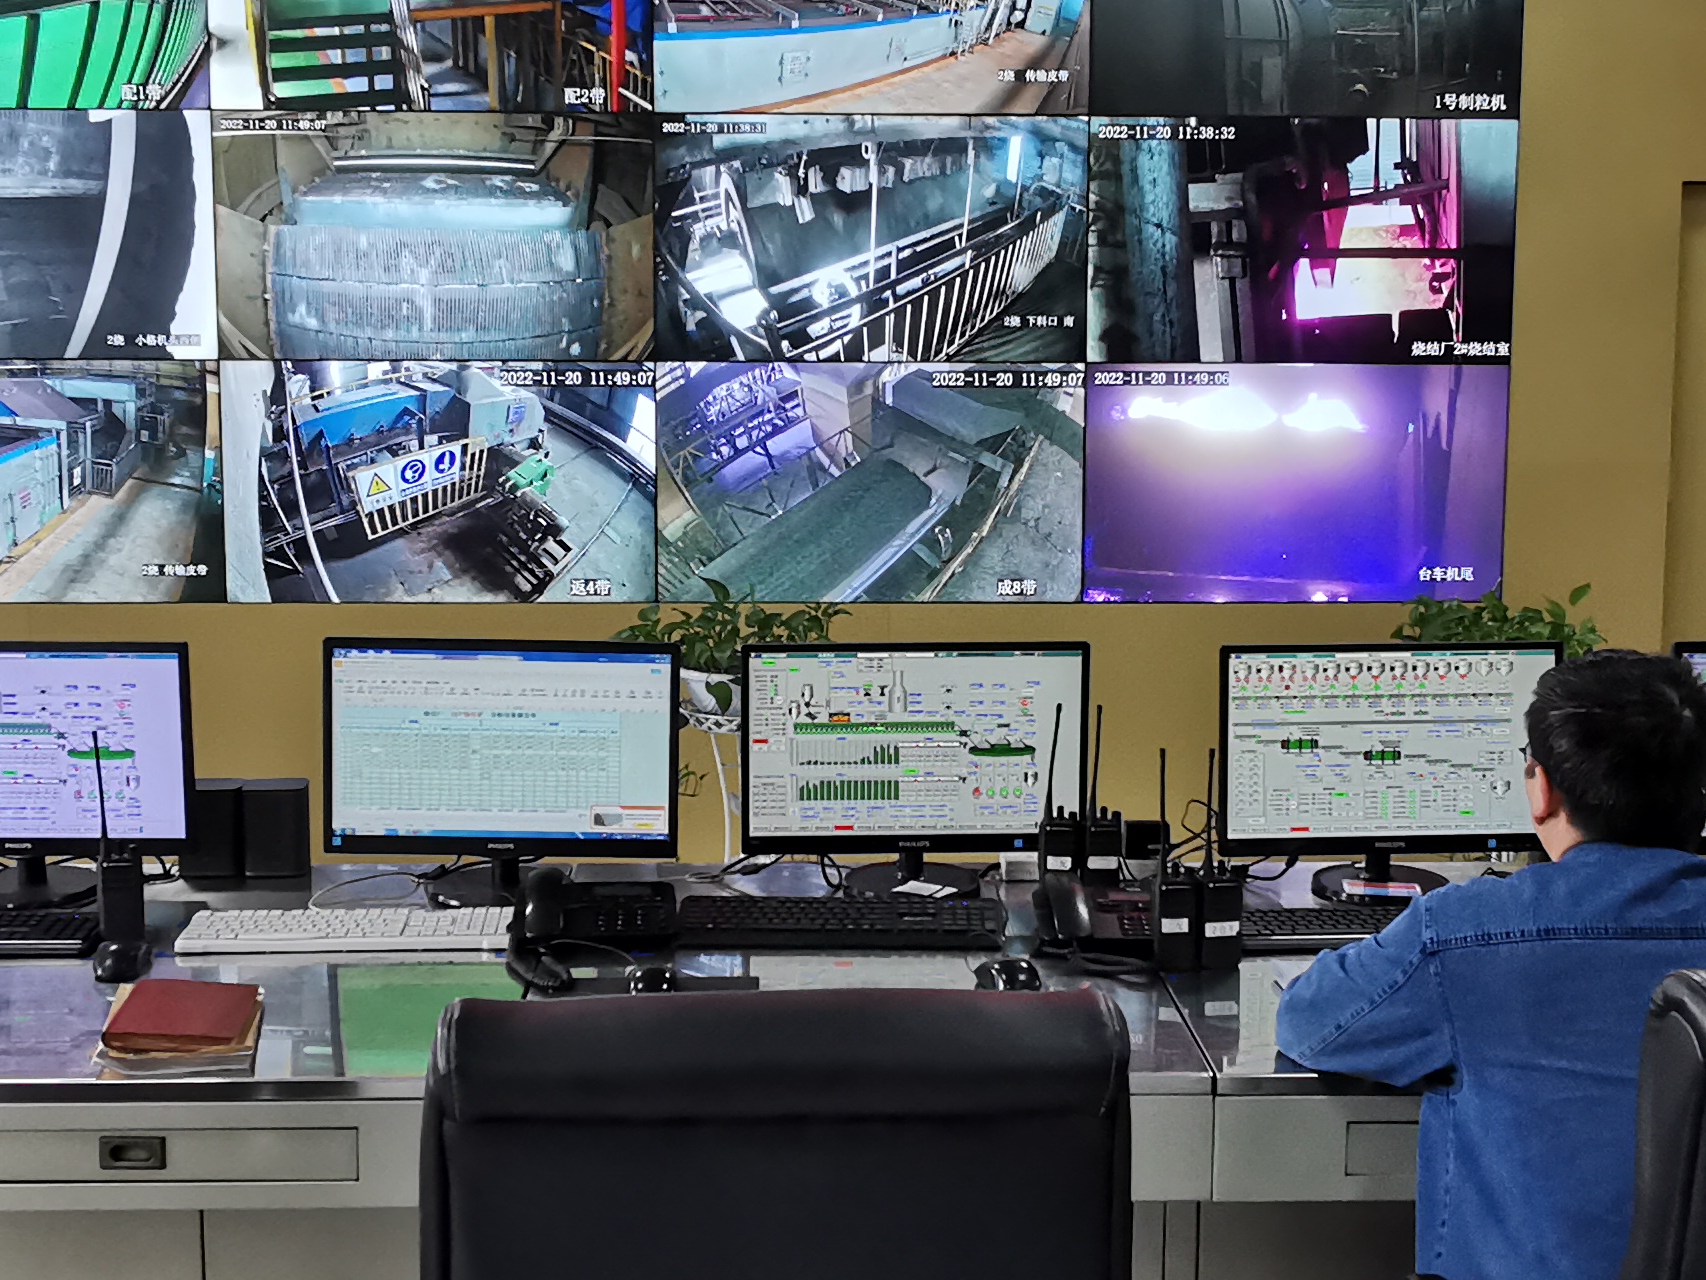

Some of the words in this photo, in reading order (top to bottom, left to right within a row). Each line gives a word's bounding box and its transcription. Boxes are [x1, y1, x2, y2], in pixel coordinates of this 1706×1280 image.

[564, 87, 606, 104] 配2带
[1435, 92, 1507, 111] 1号制粒机
[220, 119, 278, 130] 2022-11-20
[662, 122, 719, 133] 2022-11-20
[1098, 125, 1172, 139] 2022-11-20
[1178, 126, 1236, 140] 11:38:32
[1026, 314, 1058, 328] 下料口
[1410, 340, 1511, 356] 烧结厂2#烧结室
[500, 371, 583, 385] 2022-11-20
[590, 371, 655, 386] 11:49:07
[931, 372, 1013, 387] 2022-11-20
[1021, 372, 1085, 387] 11:49:07
[1094, 372, 1167, 385] 2022-11-20
[1173, 373, 1229, 385] 11:49:06
[1418, 566, 1475, 582] 台车机尾
[569, 579, 612, 596] 返4带
[997, 579, 1038, 596] 成8带
